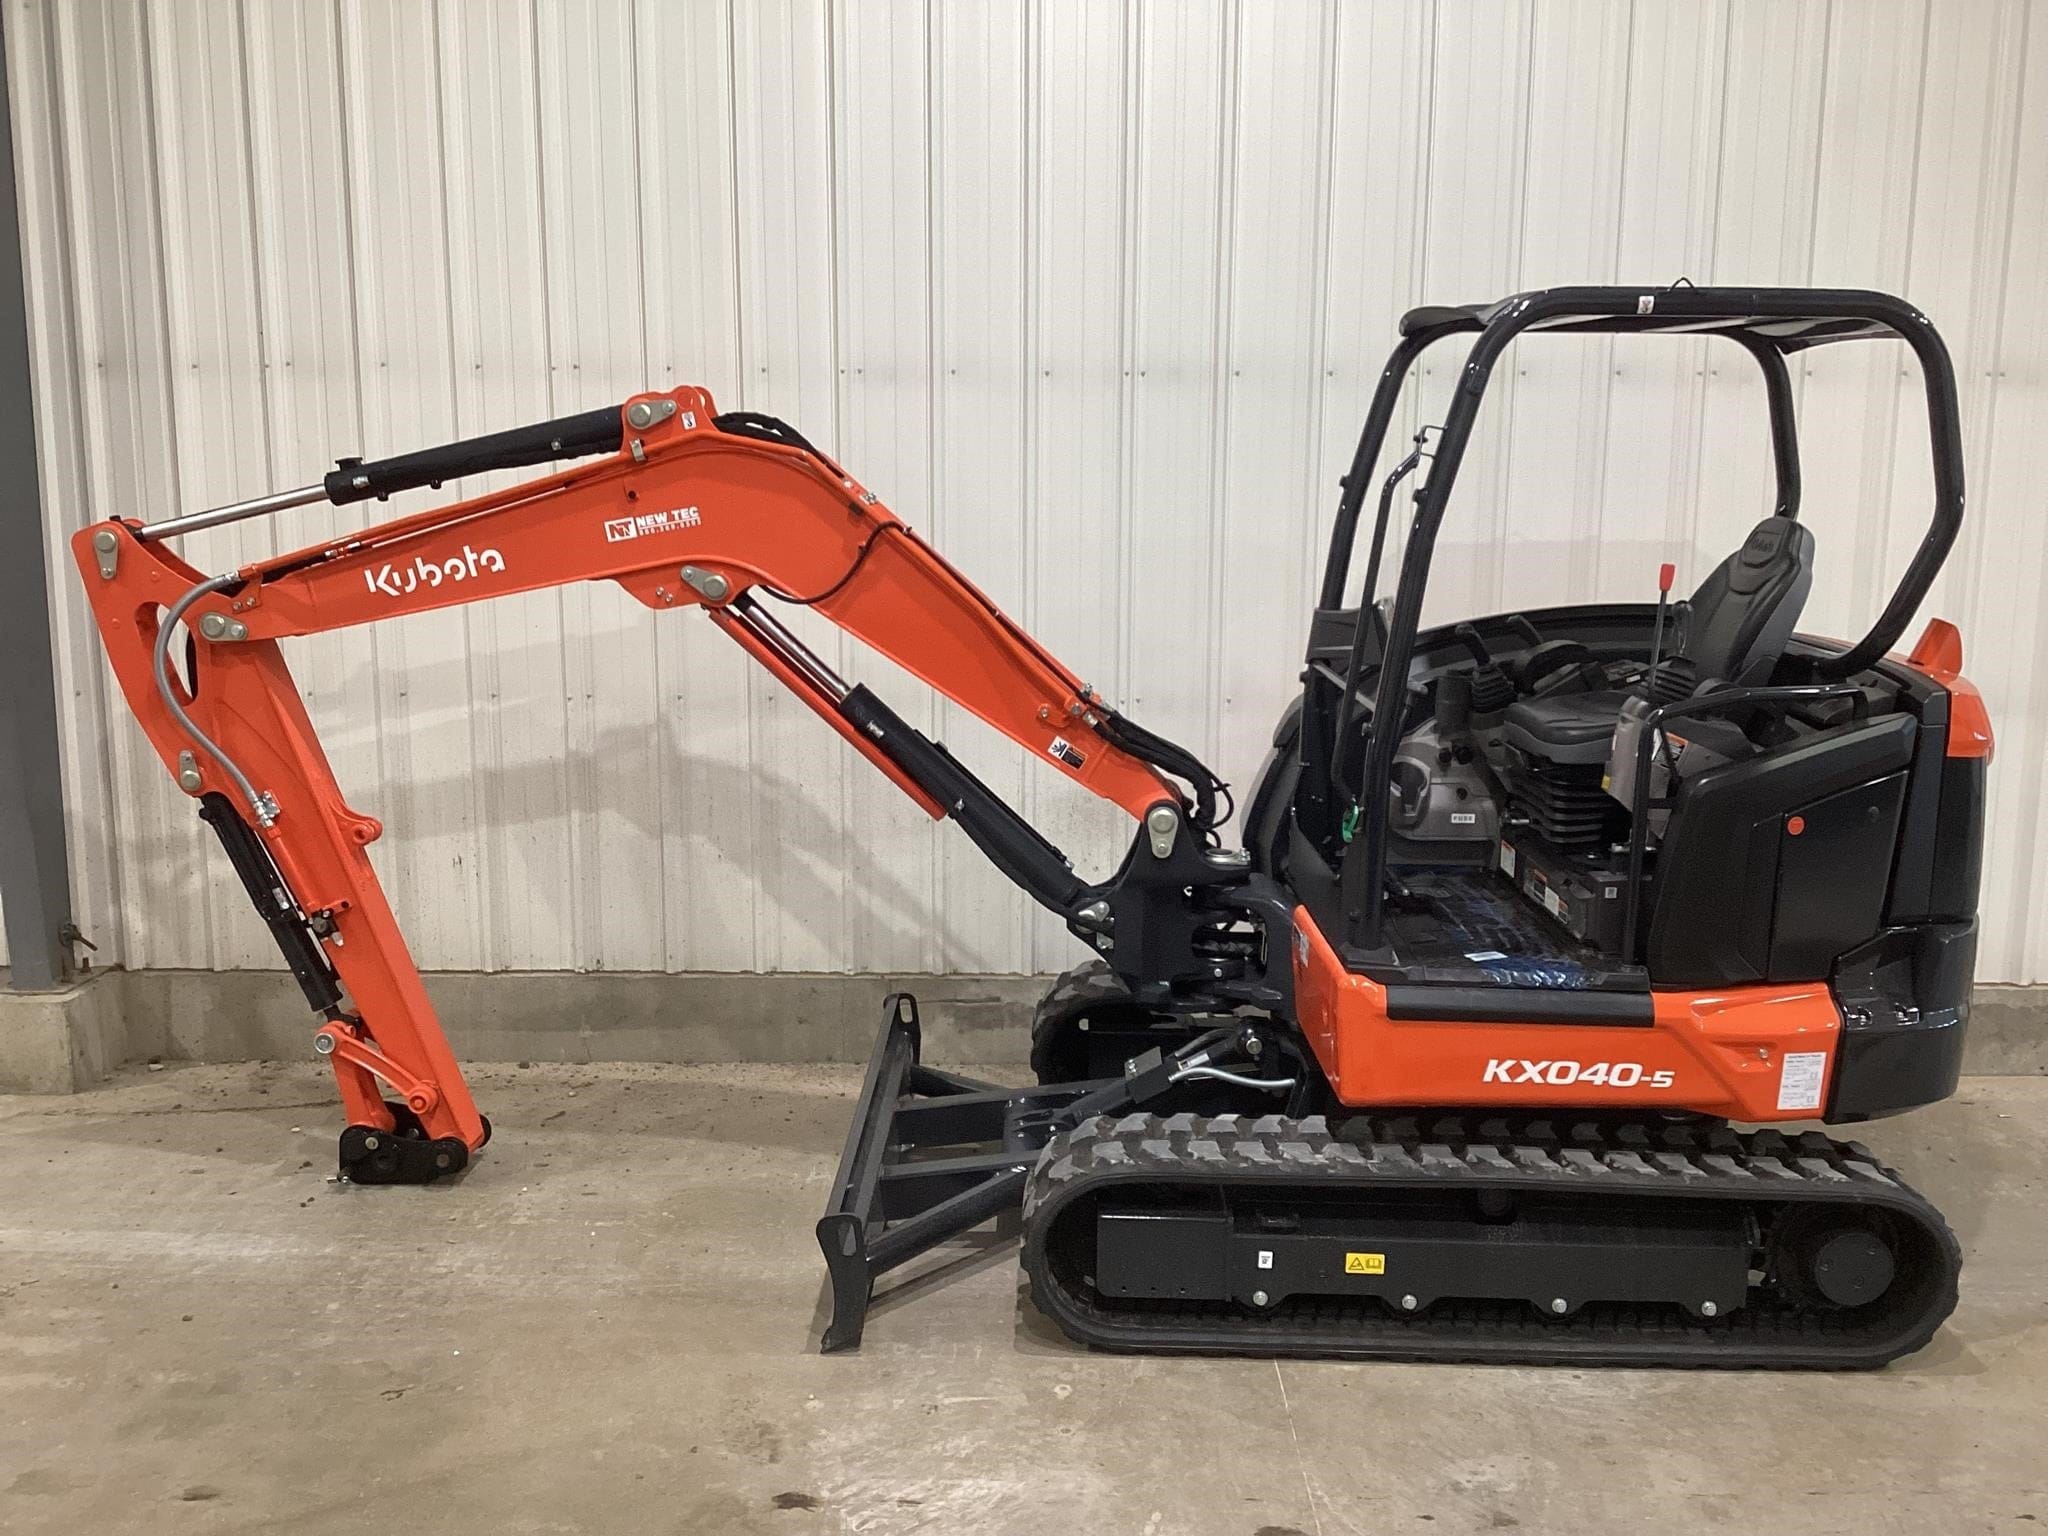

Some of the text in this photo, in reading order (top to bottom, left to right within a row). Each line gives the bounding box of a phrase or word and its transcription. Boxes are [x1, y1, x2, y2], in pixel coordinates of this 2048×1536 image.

[636, 511, 668, 528] NEW
[671, 506, 699, 521] TEC
[364, 545, 506, 597] Kubota
[1482, 1058, 1676, 1089] KX040-5
